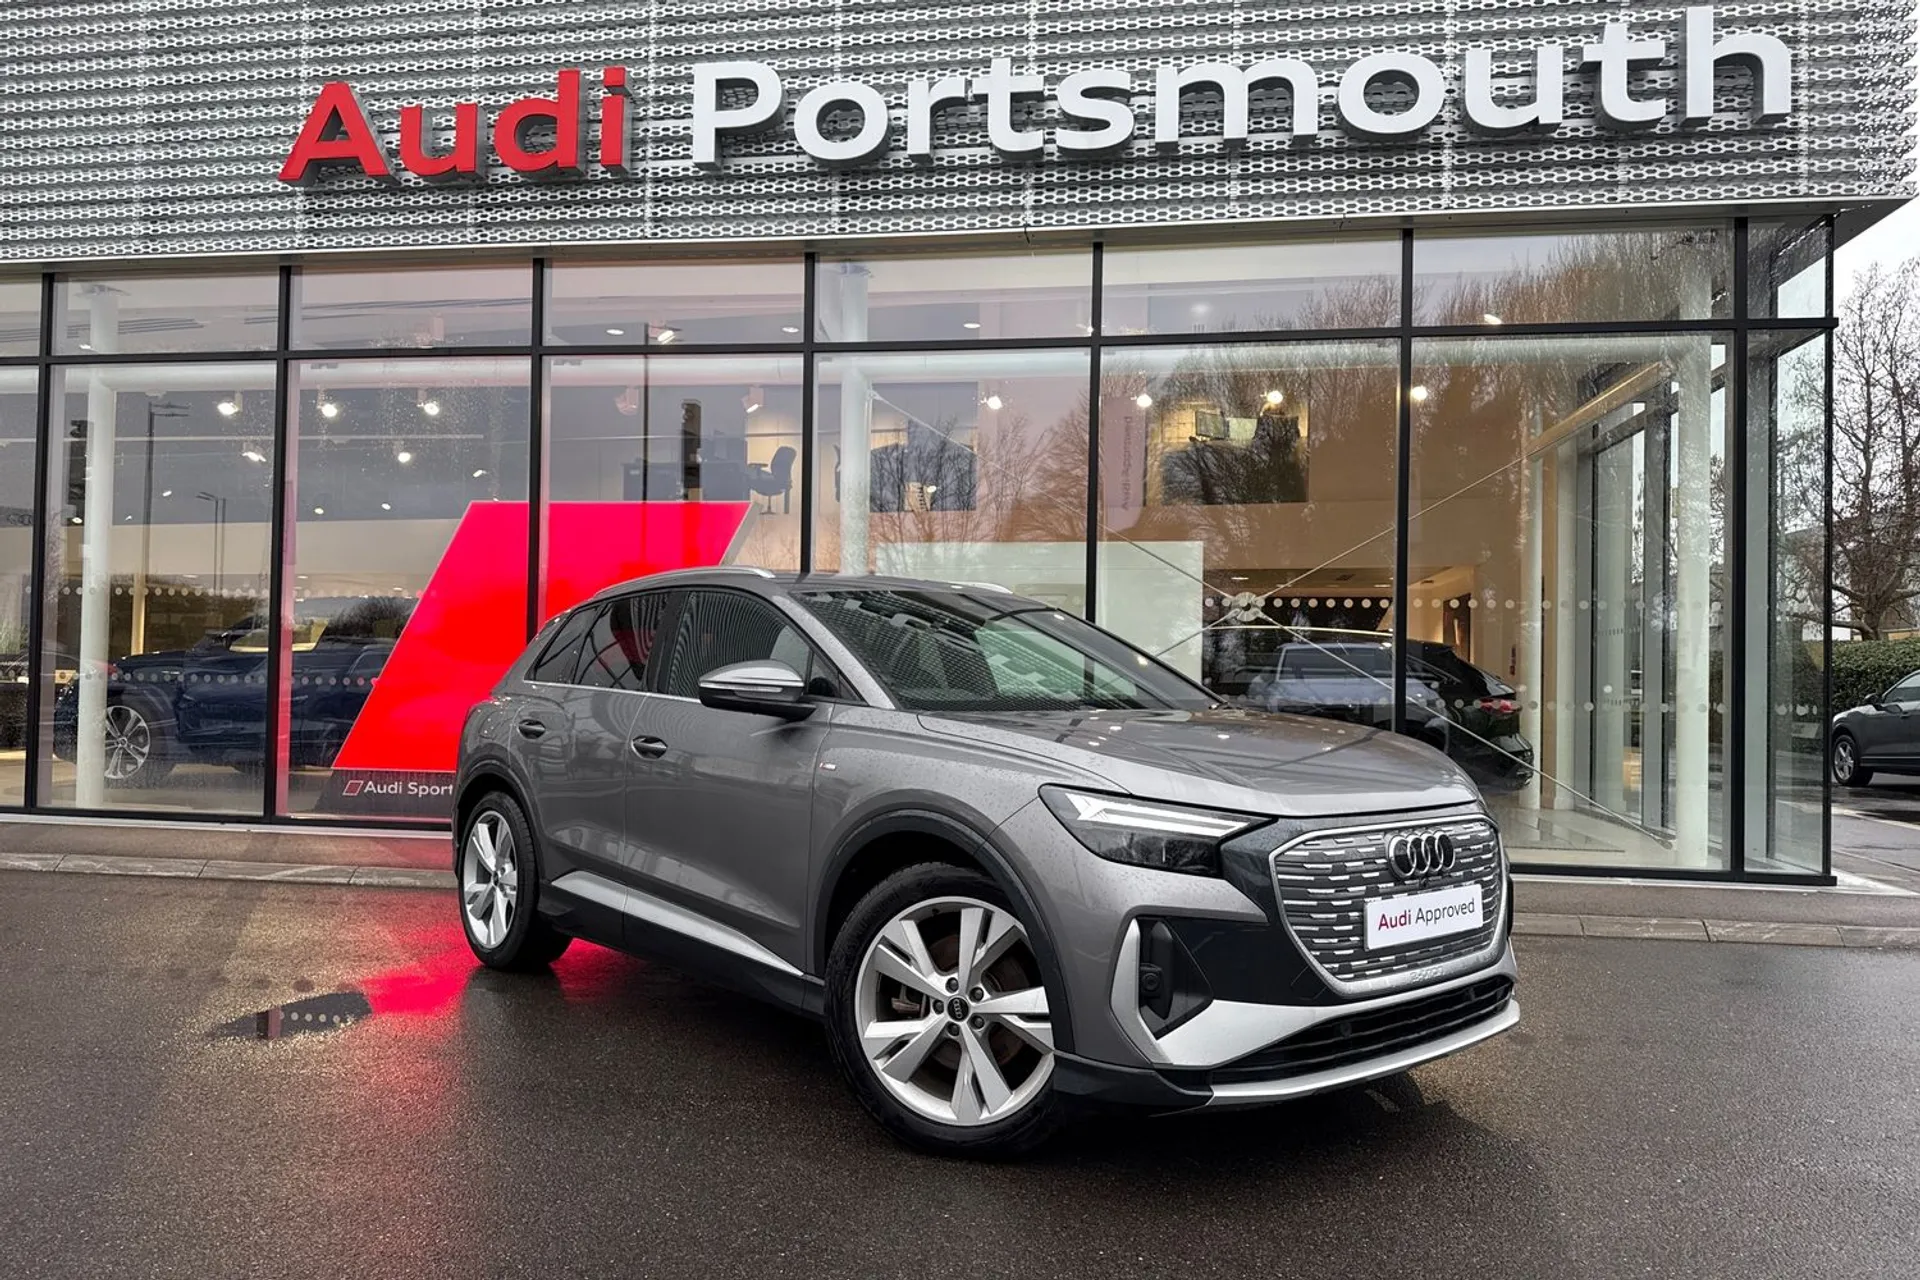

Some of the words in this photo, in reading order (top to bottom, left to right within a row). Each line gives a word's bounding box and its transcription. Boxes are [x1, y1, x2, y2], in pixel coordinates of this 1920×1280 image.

[278, 66, 630, 182] Audi
[692, 6, 1793, 166] Portsmouth
[364, 781, 403, 794] Audi
[407, 782, 454, 798] Sport
[1378, 910, 1412, 931] Audi
[1415, 898, 1475, 926] Approved
